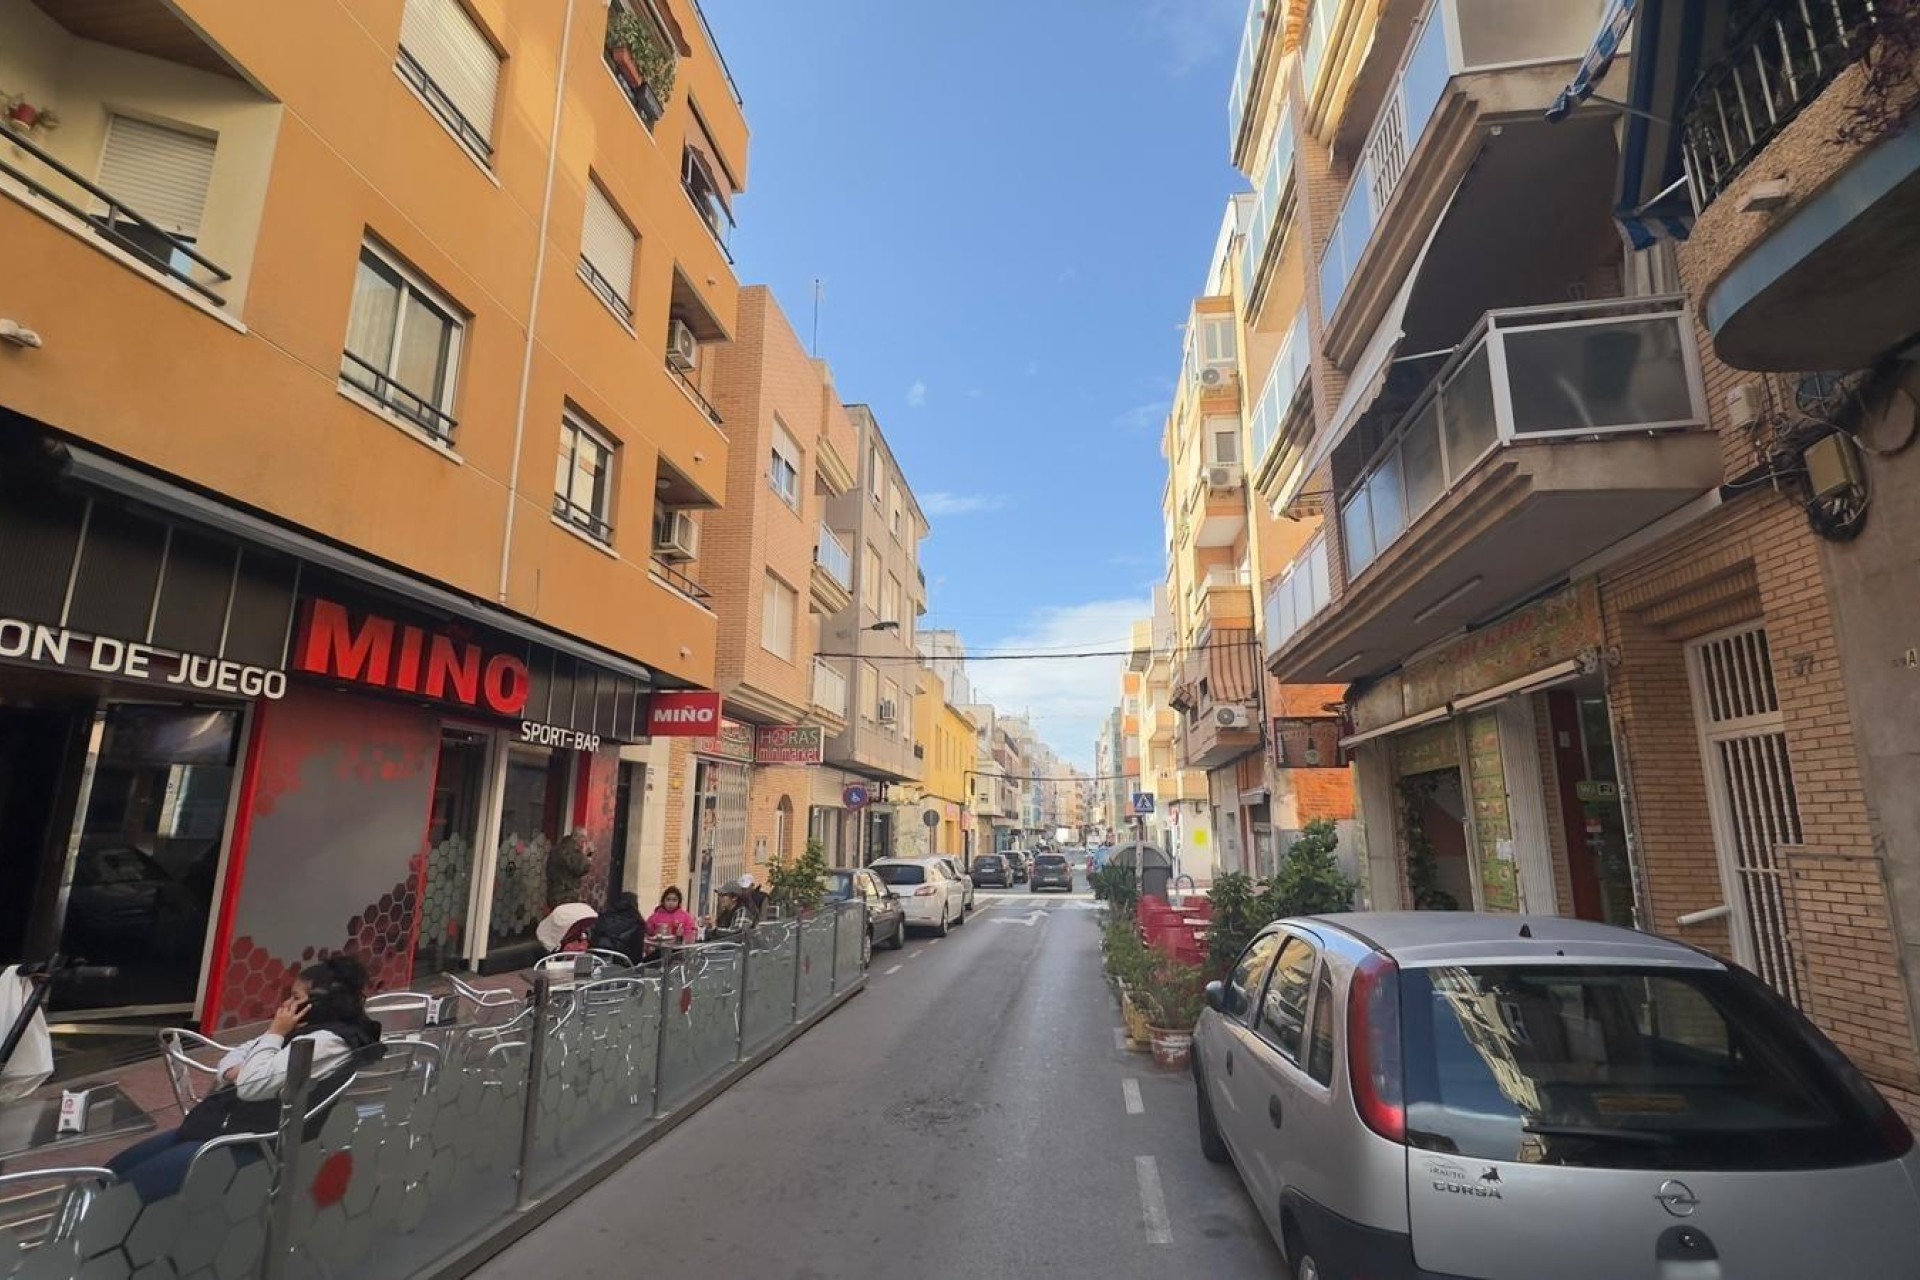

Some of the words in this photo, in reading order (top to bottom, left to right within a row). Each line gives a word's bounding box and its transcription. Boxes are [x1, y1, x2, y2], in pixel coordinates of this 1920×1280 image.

[90, 635, 149, 679] DE
[167, 653, 287, 700] JUEGO
[301, 598, 531, 716] MIÑO
[653, 704, 714, 722] MIÑO
[520, 719, 601, 753] SPORT-BAR
[760, 748, 818, 762] minimarket
[1431, 1181, 1503, 1200] CORSA
